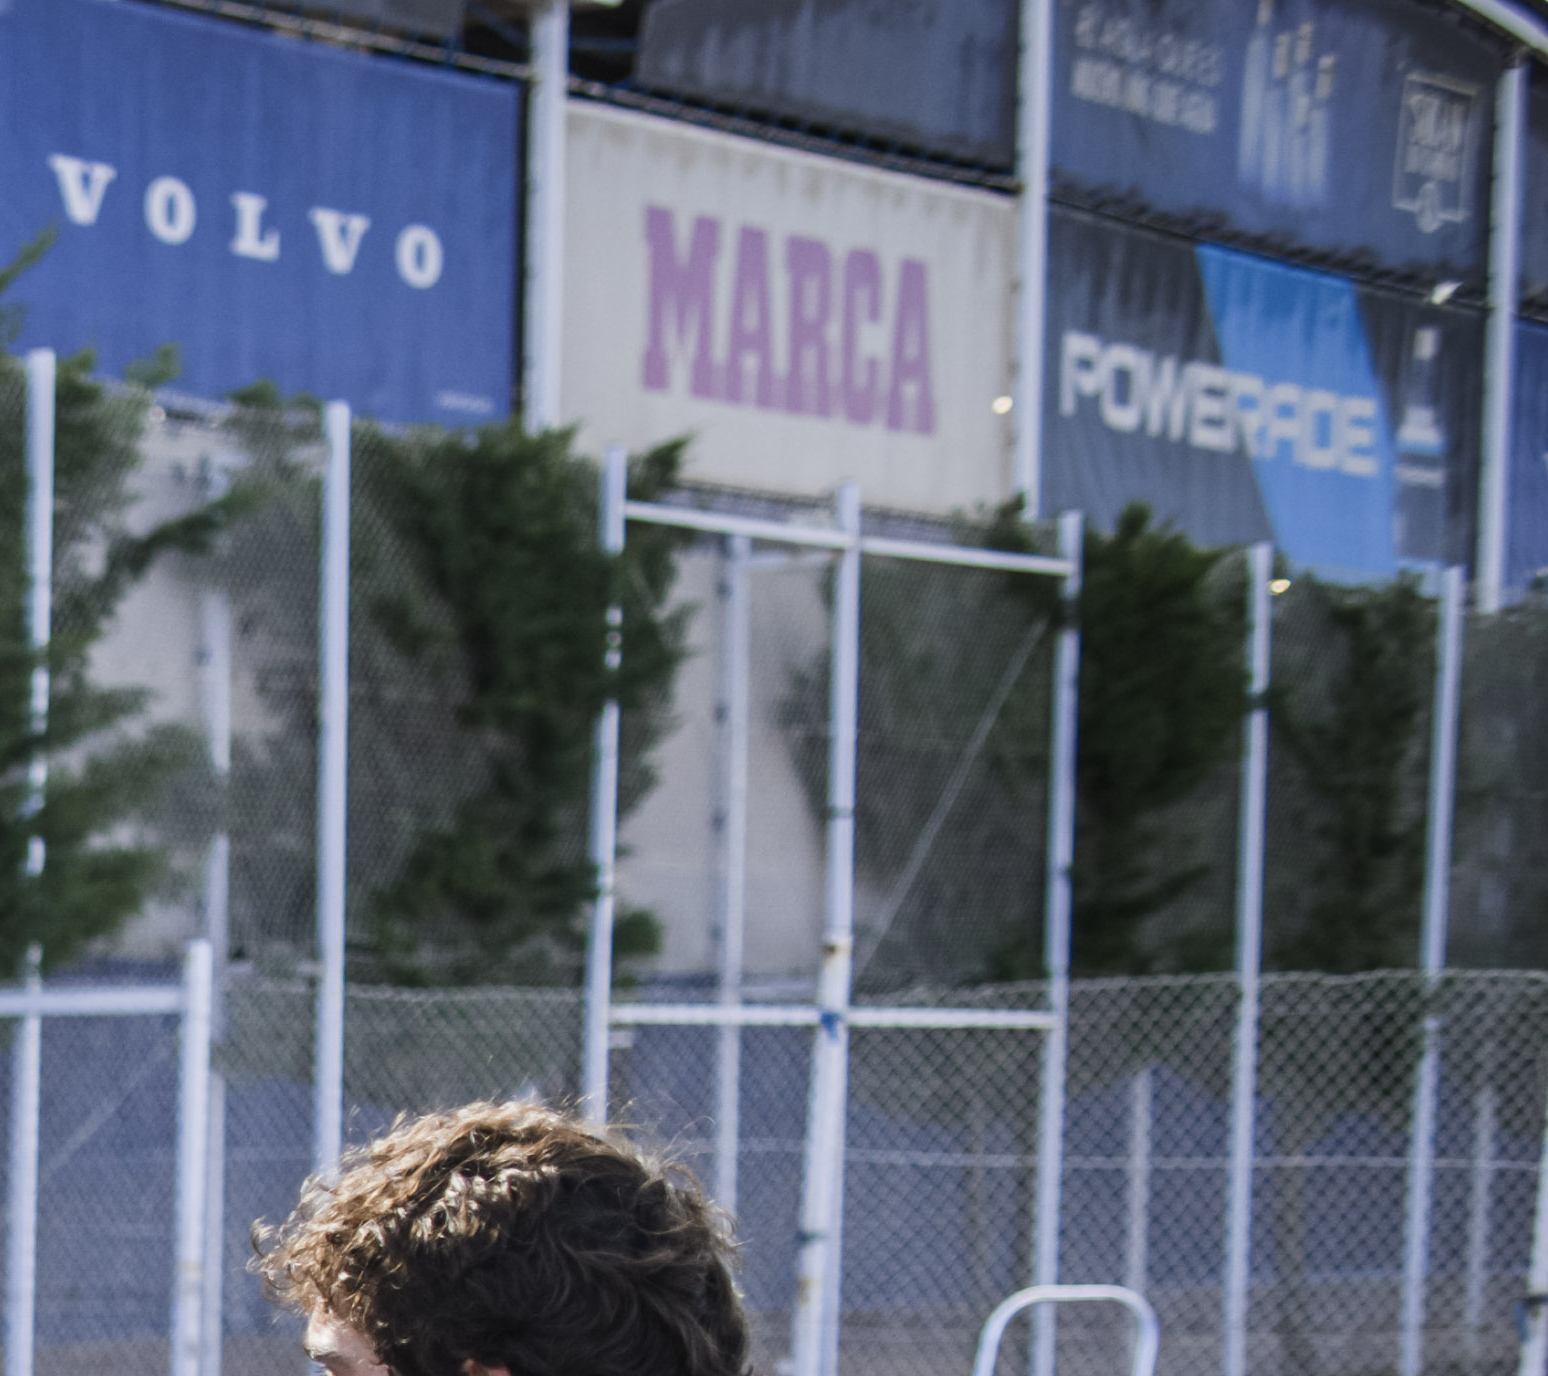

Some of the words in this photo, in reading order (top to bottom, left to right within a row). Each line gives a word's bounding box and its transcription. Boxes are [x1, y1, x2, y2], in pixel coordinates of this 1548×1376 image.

[47, 154, 444, 289] VOLVO
[643, 205, 935, 436] MARCA
[1058, 330, 1380, 478] POWERADE
